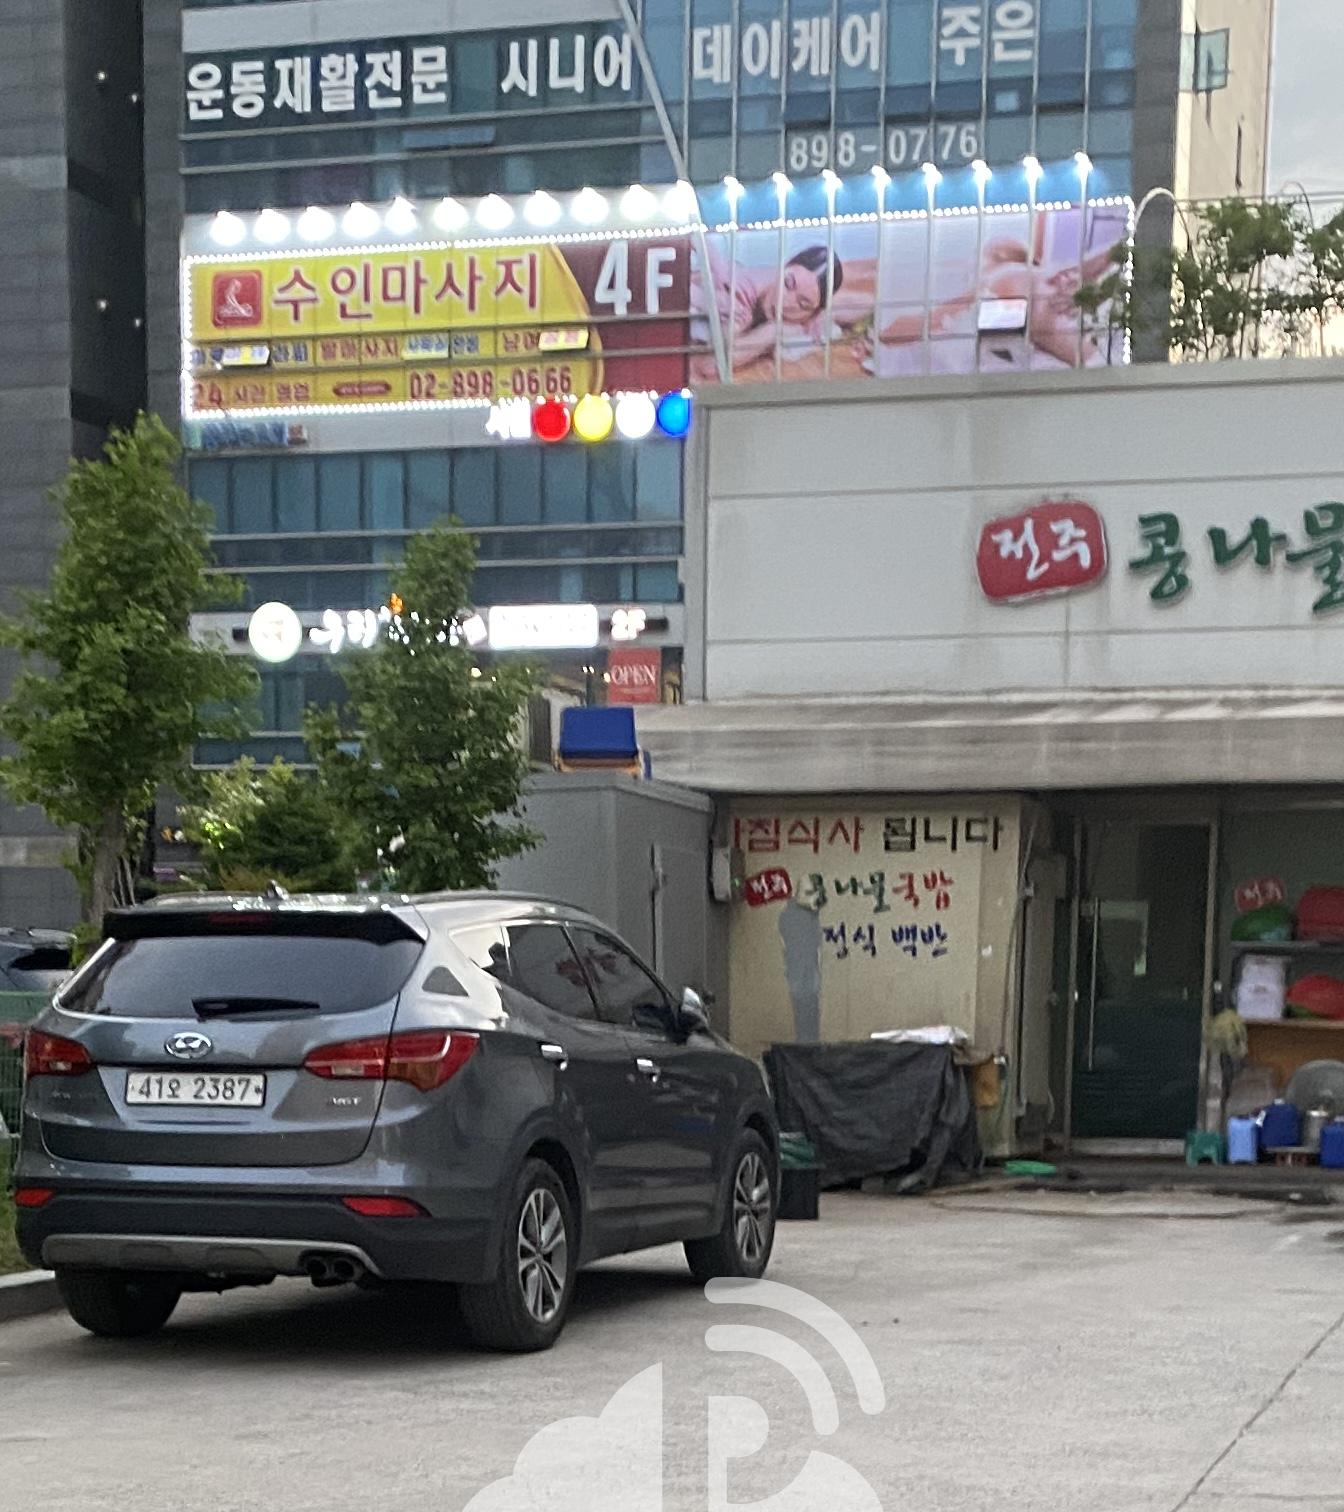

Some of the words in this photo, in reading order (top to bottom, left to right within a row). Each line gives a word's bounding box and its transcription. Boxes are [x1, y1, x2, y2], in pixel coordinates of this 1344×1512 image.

[185, 45, 448, 121] 운동재활전문
[501, 32, 635, 97] 시니어
[692, 11, 882, 84] 데이케어
[939, 0, 1036, 67] 주은
[789, 123, 980, 172] 898-0776
[272, 251, 539, 322] 수인마사지
[594, 240, 677, 316] 4F
[410, 365, 572, 400] 02-898-0666
[989, 518, 1093, 581] 전주
[611, 664, 656, 685] OPEN
[883, 816, 1003, 853] 됩니다
[138, 1077, 182, 1100] 41오
[193, 1076, 251, 1100] 2387
